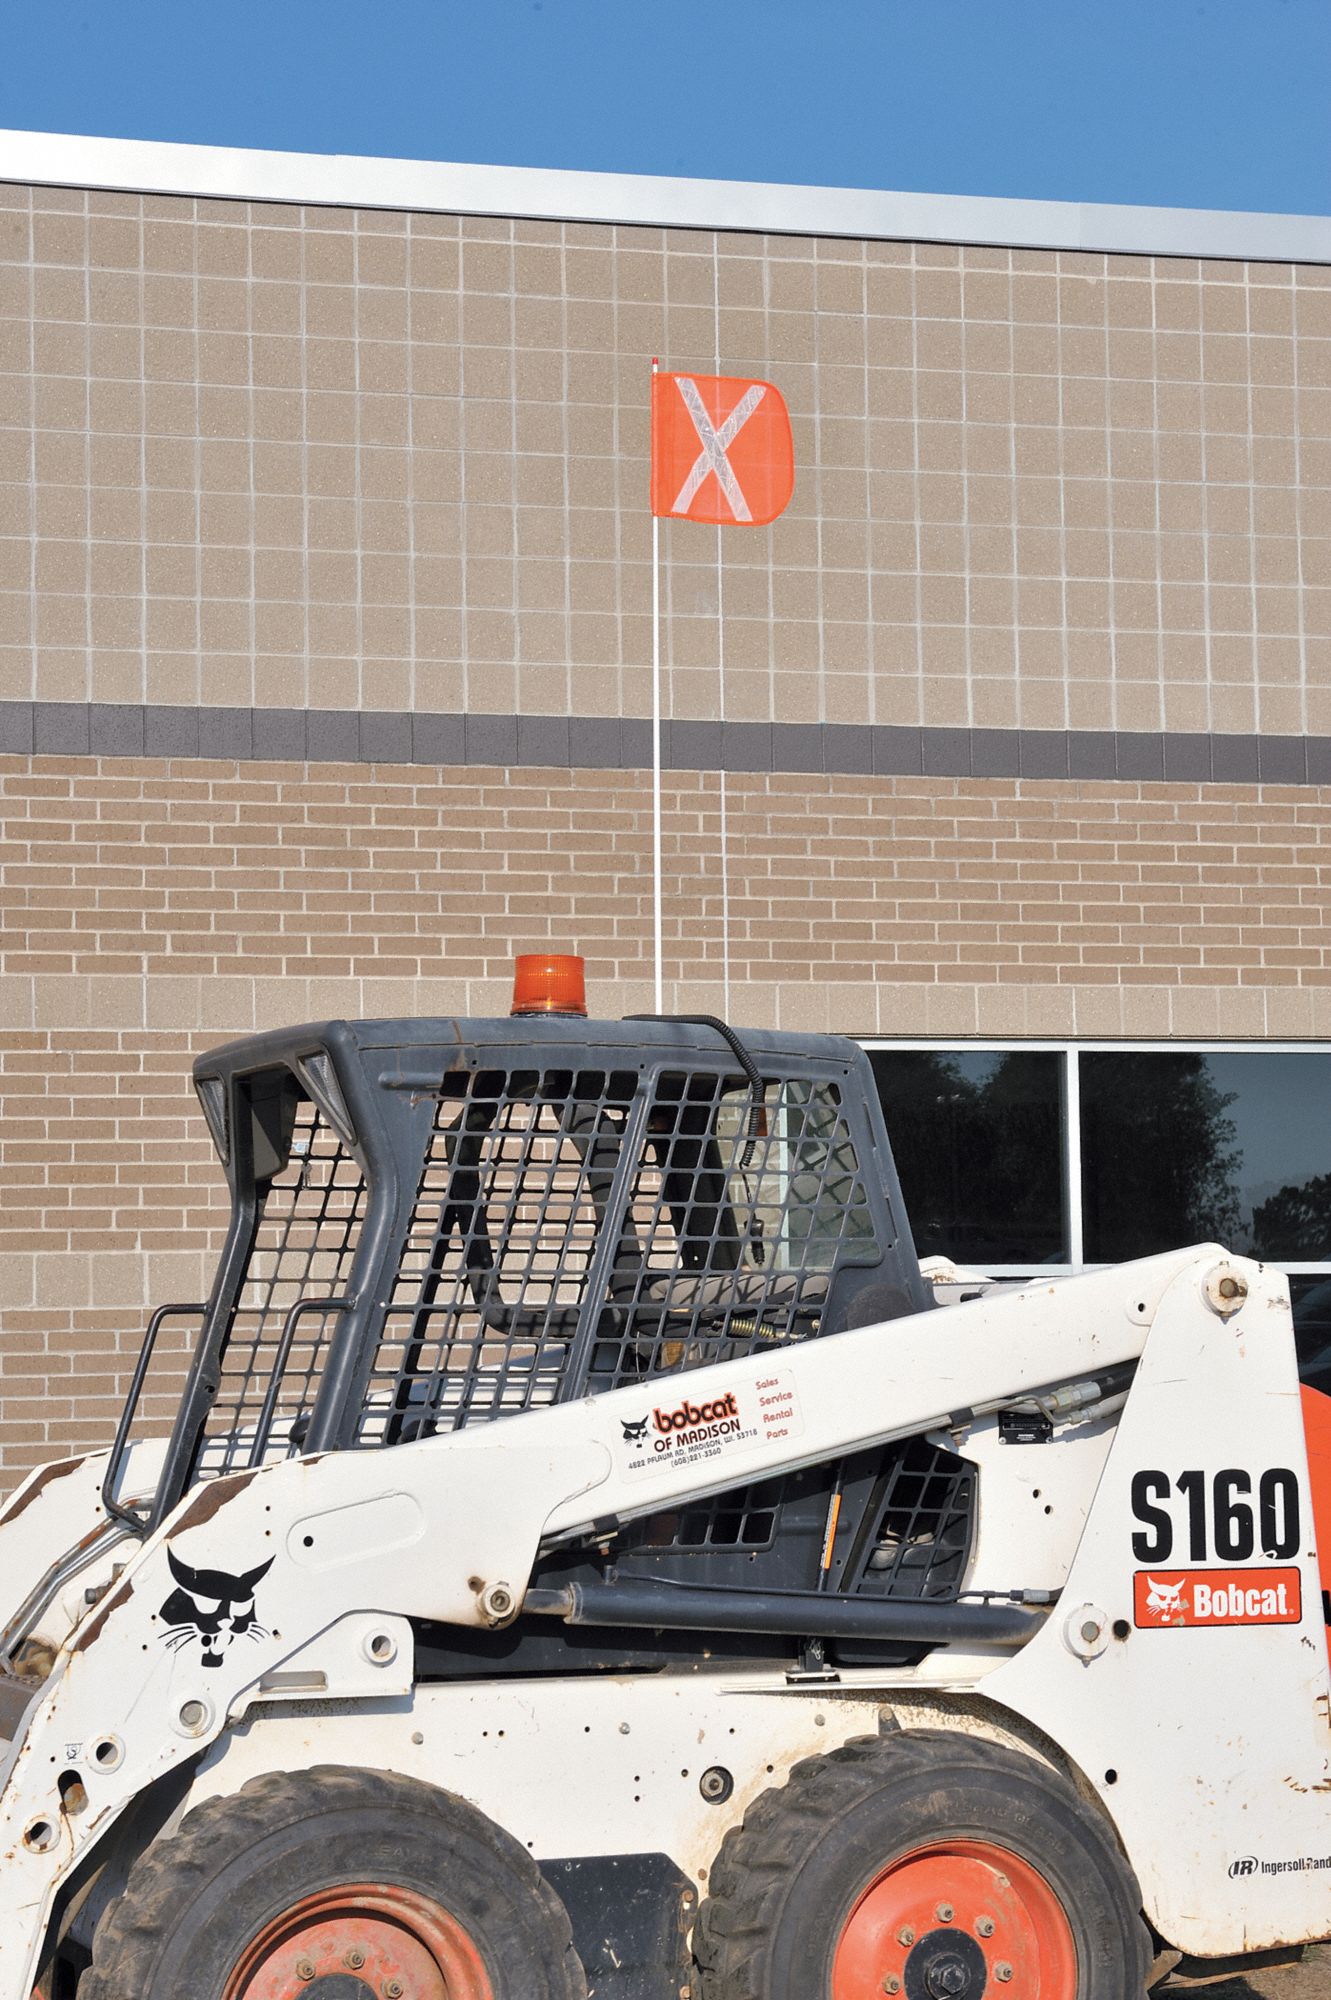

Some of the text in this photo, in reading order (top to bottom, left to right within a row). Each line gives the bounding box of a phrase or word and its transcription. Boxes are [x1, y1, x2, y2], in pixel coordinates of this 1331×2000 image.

[755, 1378, 780, 1390] Sales
[759, 1392, 793, 1407] Service
[653, 1392, 739, 1435] bobcat
[762, 1407, 794, 1423] Rental
[646, 1451, 674, 1465] PFLAUM
[736, 1427, 759, 1440] 53718
[653, 1418, 741, 1453] OF MADISON
[766, 1428, 789, 1440] Parts
[1131, 1467, 1301, 1563] S160
[1193, 1583, 1288, 1618] Bobcat
